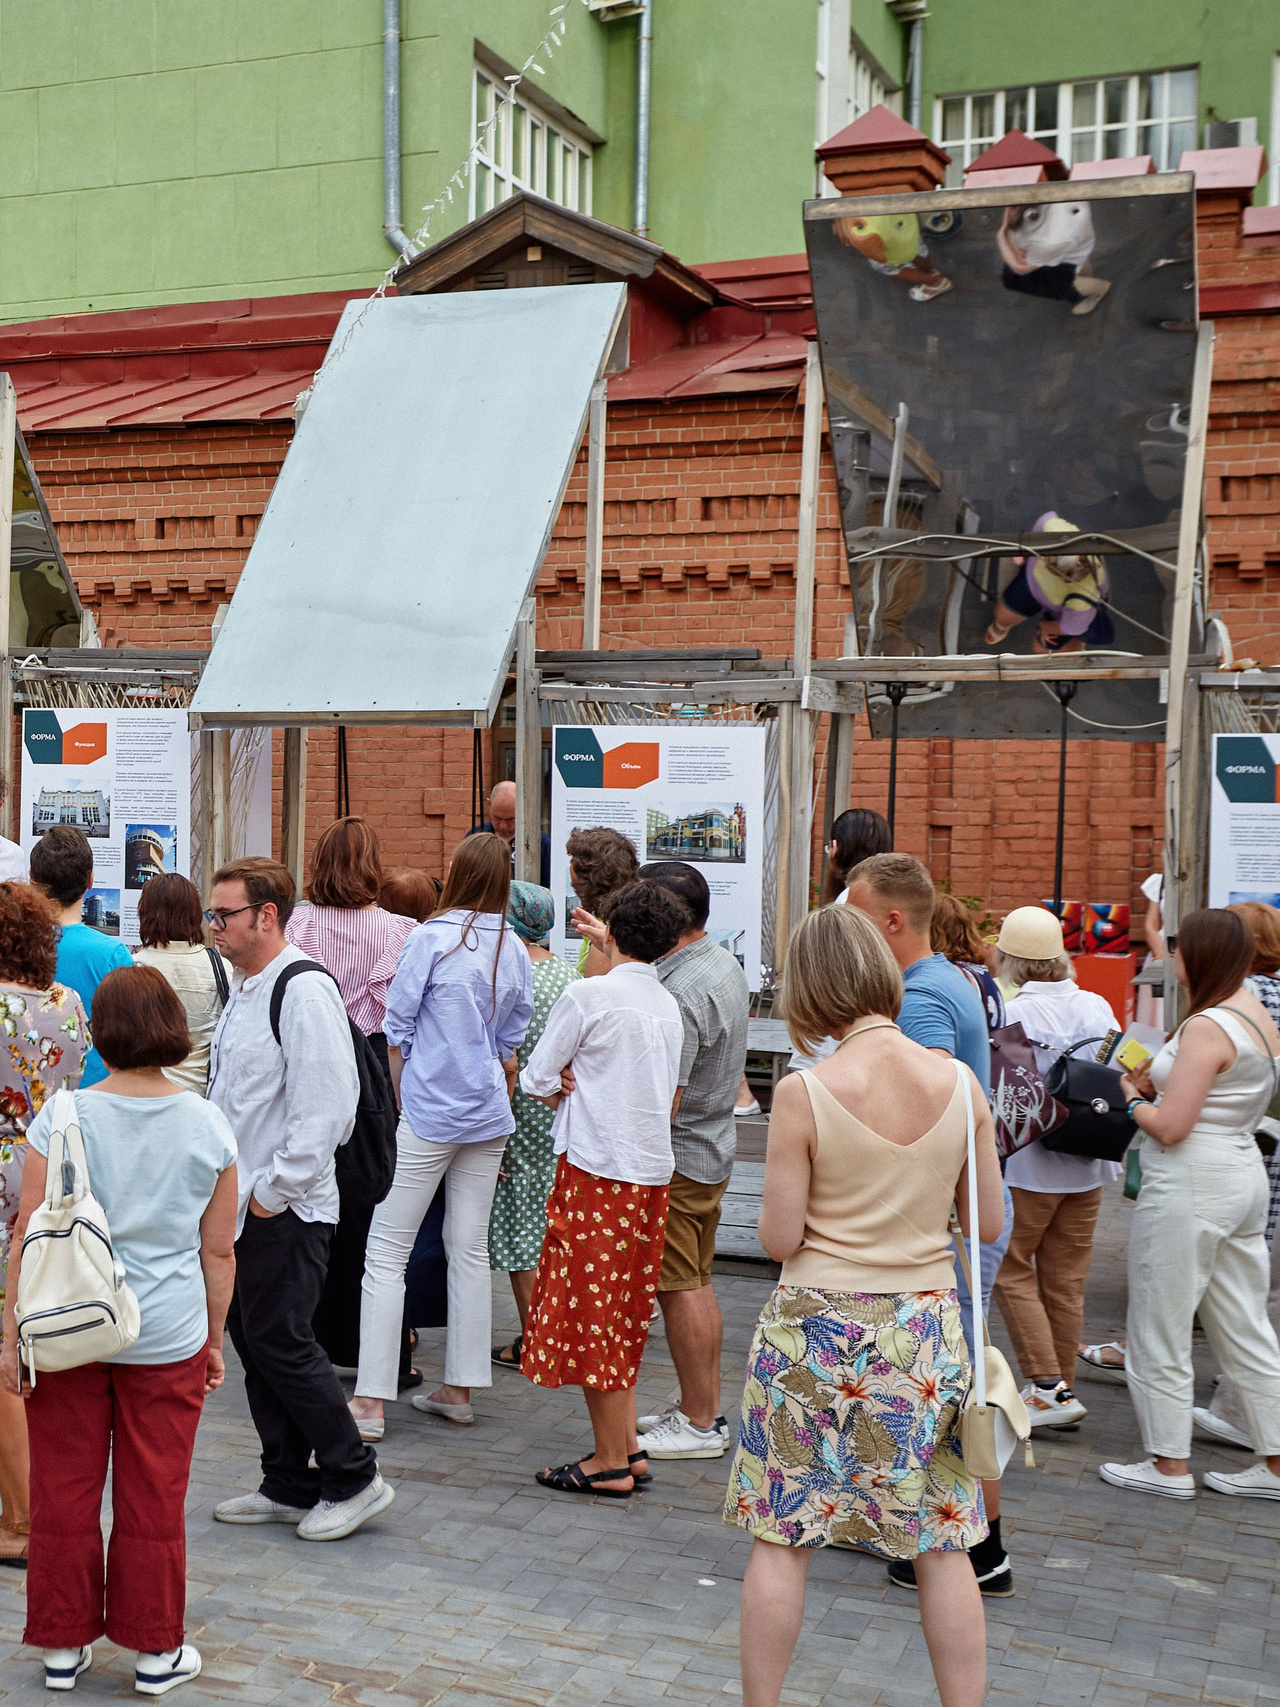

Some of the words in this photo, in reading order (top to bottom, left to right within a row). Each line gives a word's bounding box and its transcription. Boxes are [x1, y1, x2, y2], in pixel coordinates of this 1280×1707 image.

[30, 733, 56, 741] ФОРМА
[563, 753, 595, 762] ФОРМА
[1225, 765, 1266, 774] ФОРМА
